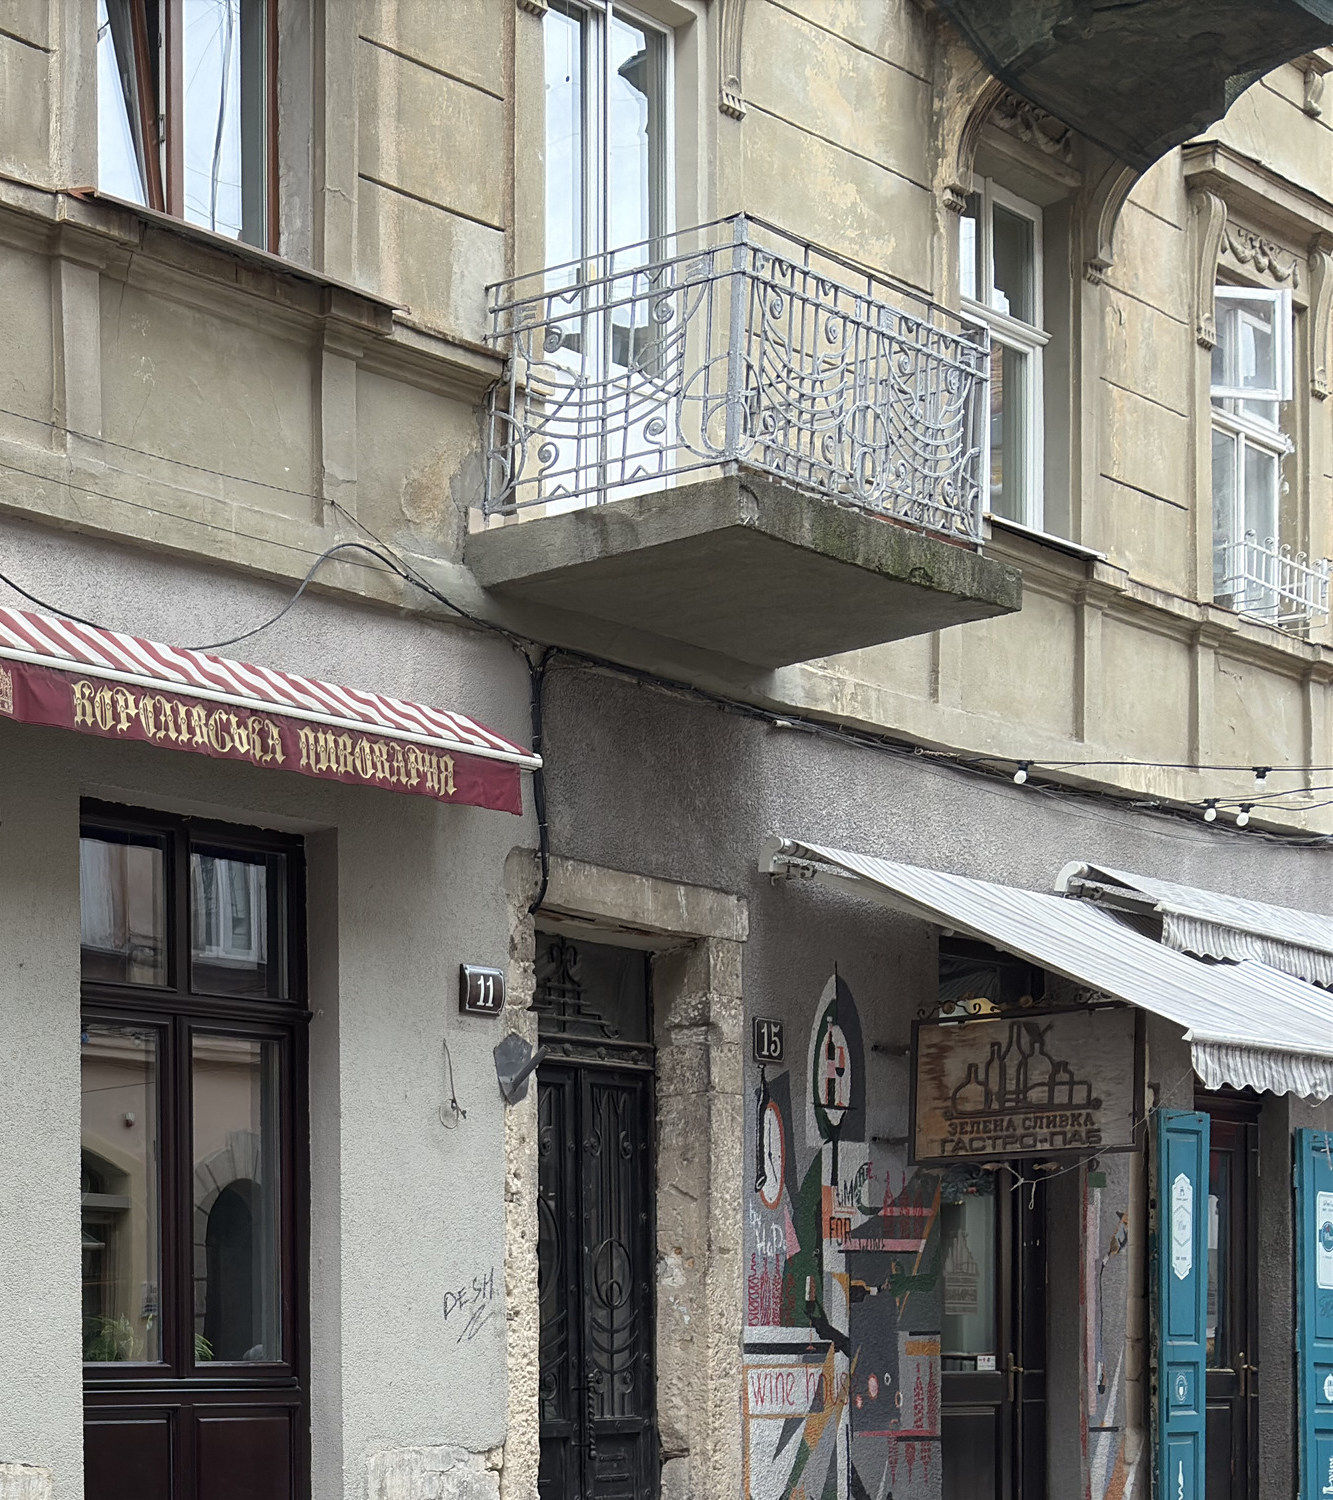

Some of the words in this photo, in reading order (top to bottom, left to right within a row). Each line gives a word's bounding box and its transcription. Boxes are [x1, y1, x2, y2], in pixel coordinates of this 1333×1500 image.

[71, 680, 287, 765] КОРОЛІВСЬКА
[297, 726, 457, 796] ПИВОВАРНЯ
[476, 976, 495, 1008] 11
[760, 1023, 782, 1056] 15
[940, 1127, 1103, 1154] ГАСТРО-ПАБ
[947, 1116, 1017, 1137] ЗЕЛЕНА
[1022, 1112, 1096, 1131] СЛИВКА
[751, 1371, 796, 1407] wine
